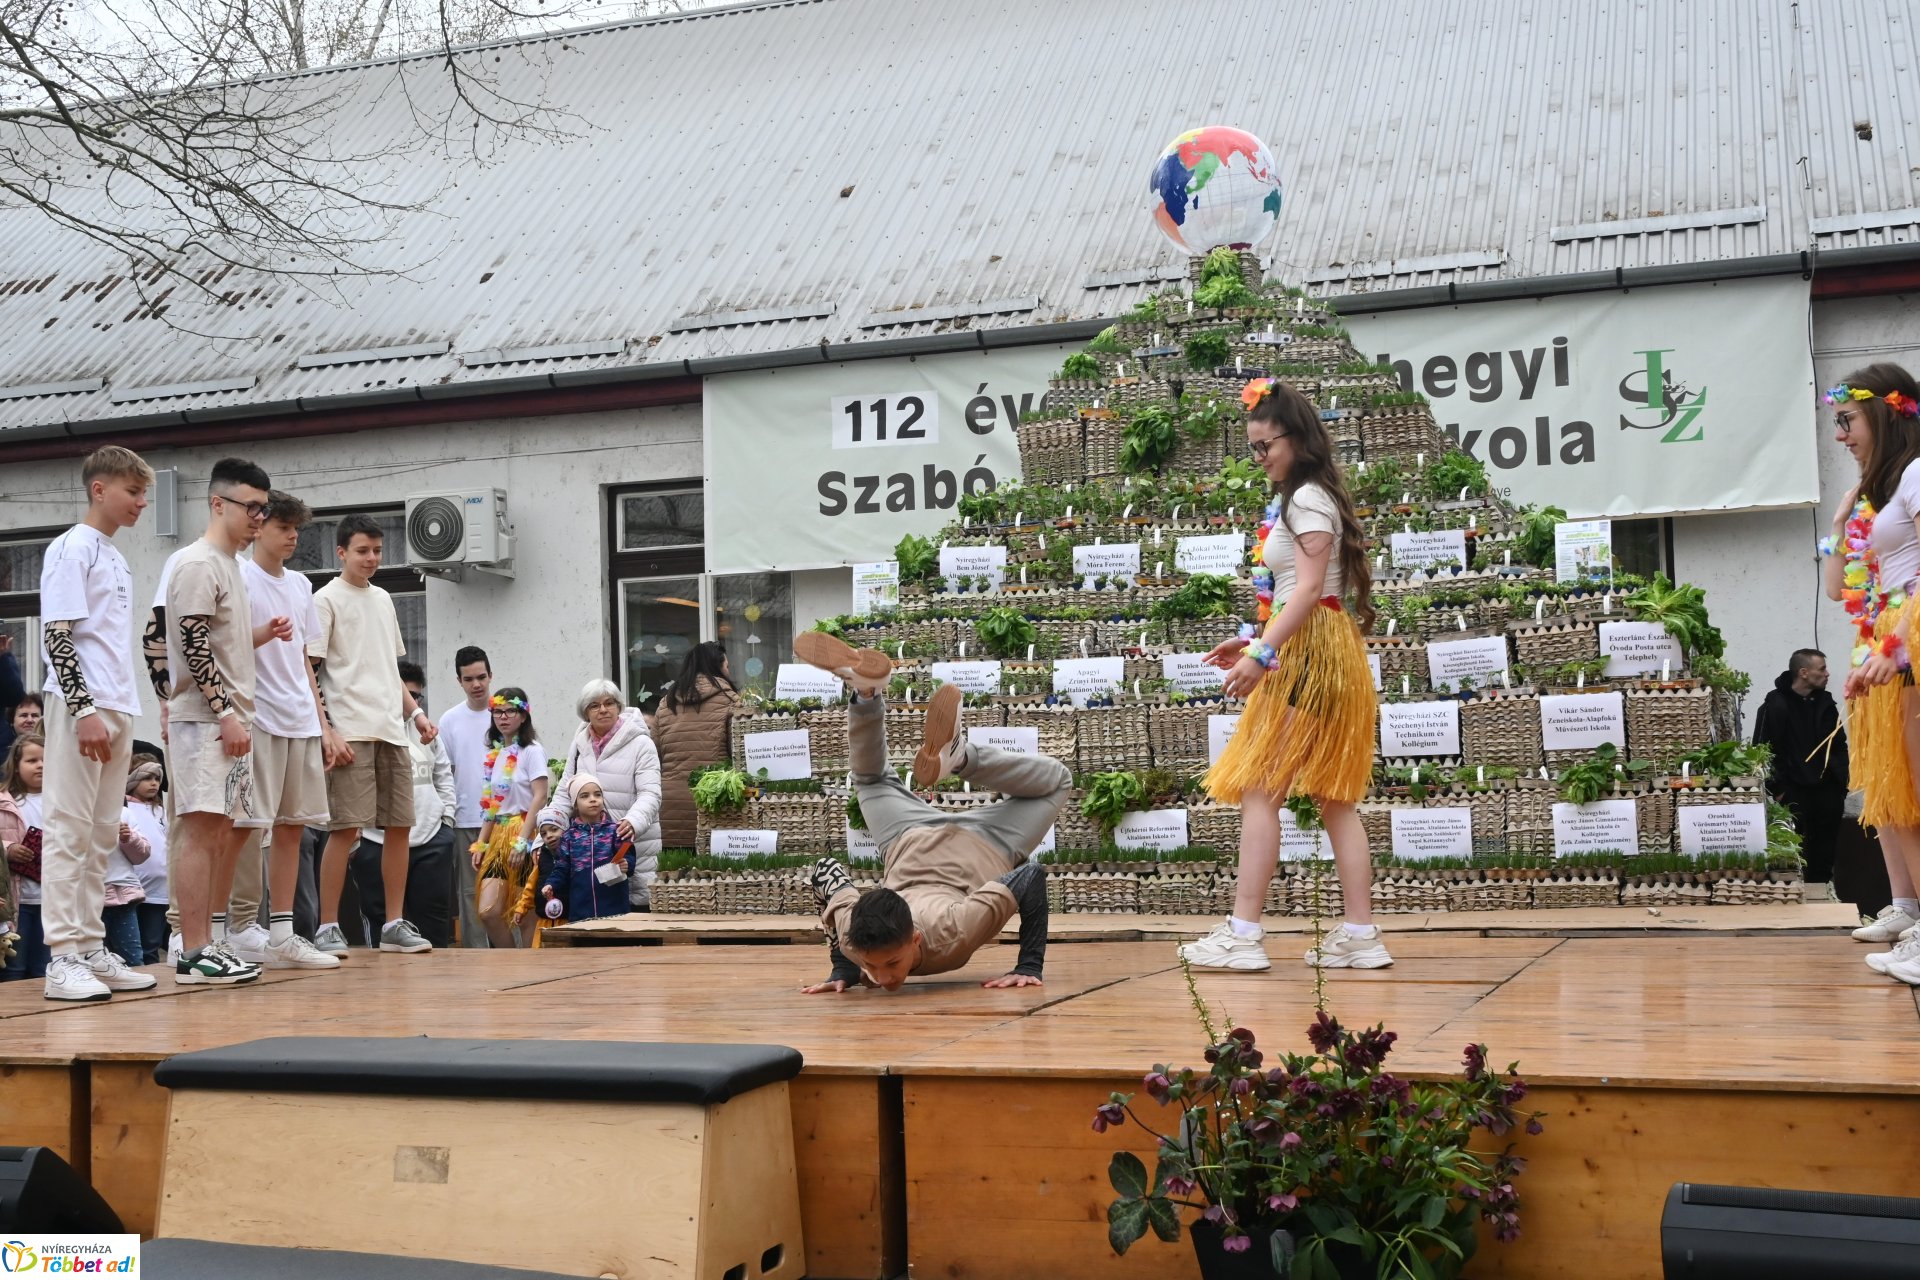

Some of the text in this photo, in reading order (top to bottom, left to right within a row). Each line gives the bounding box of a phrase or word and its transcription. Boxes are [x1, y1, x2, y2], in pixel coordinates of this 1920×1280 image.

[845, 396, 926, 442] 112
[1446, 416, 1595, 469] kola
[817, 454, 996, 516] Szabó
[1410, 537, 1445, 545] Nyíregyházi
[1649, 632, 1672, 640] Északi
[1389, 713, 1430, 721] Nyíregyházi
